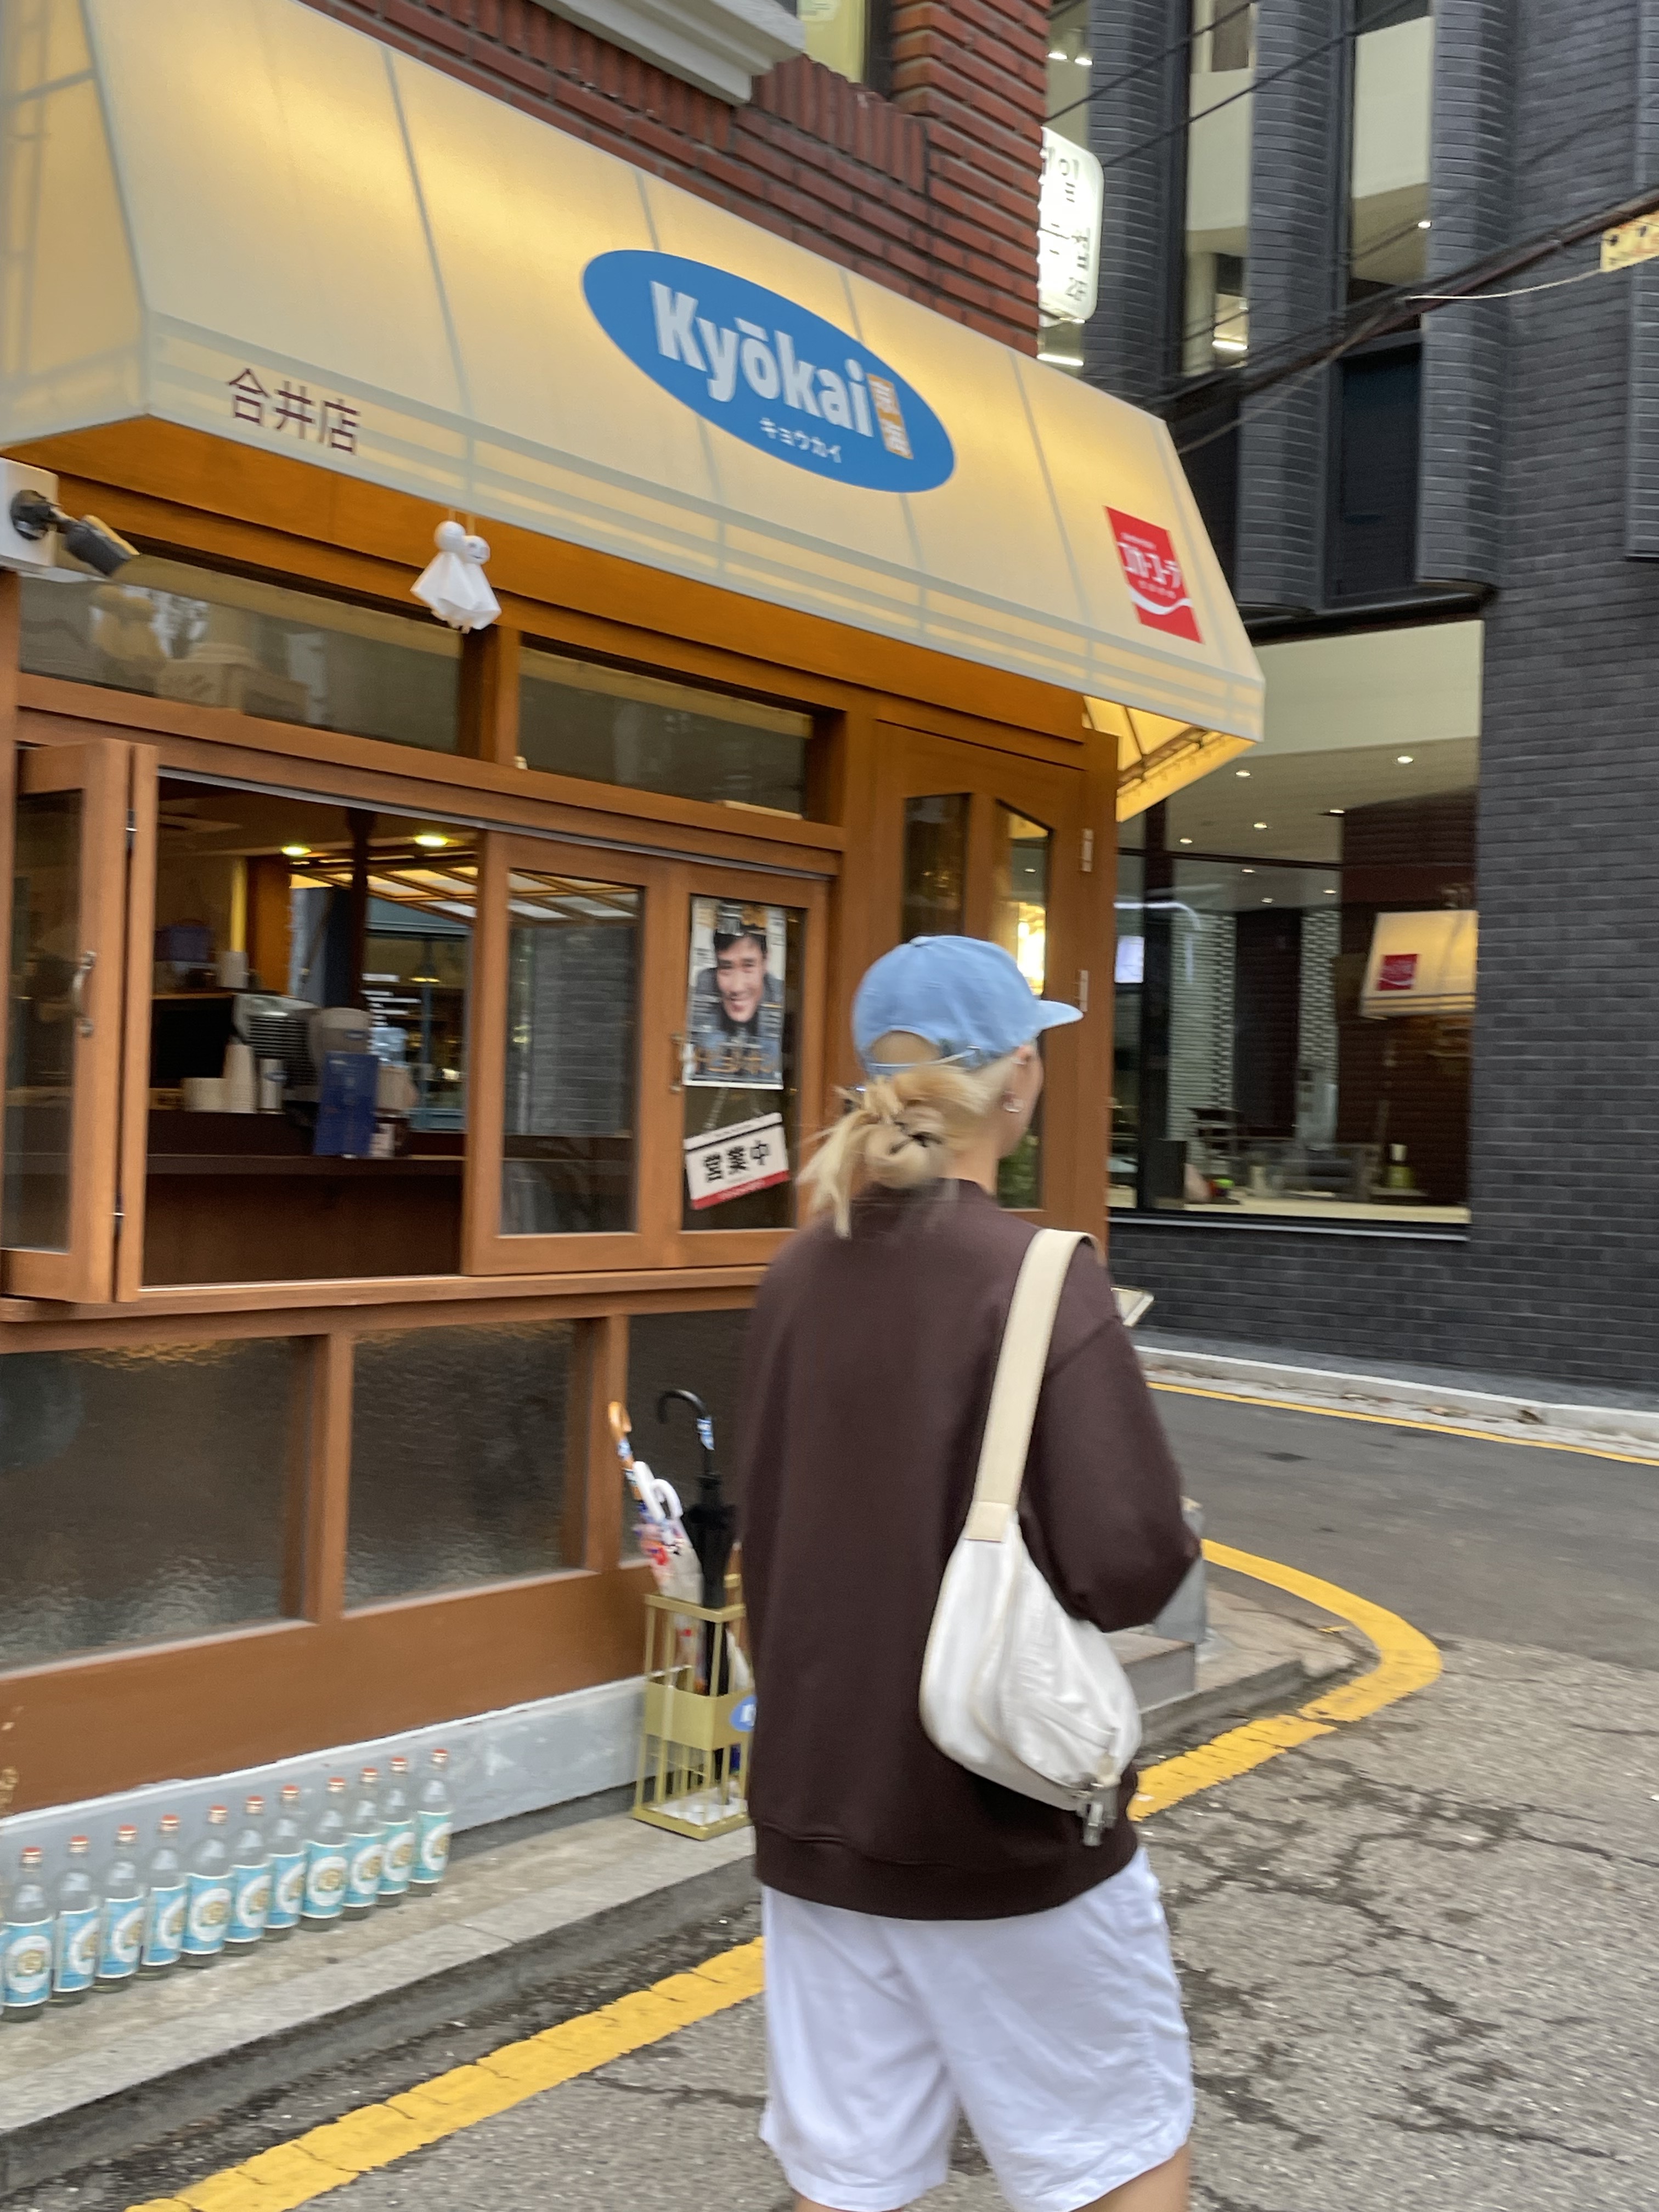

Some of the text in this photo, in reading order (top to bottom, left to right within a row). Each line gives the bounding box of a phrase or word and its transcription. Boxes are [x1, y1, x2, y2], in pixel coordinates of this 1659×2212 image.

[227, 368, 361, 455] 合井店
[650, 280, 874, 437] Kyōkai
